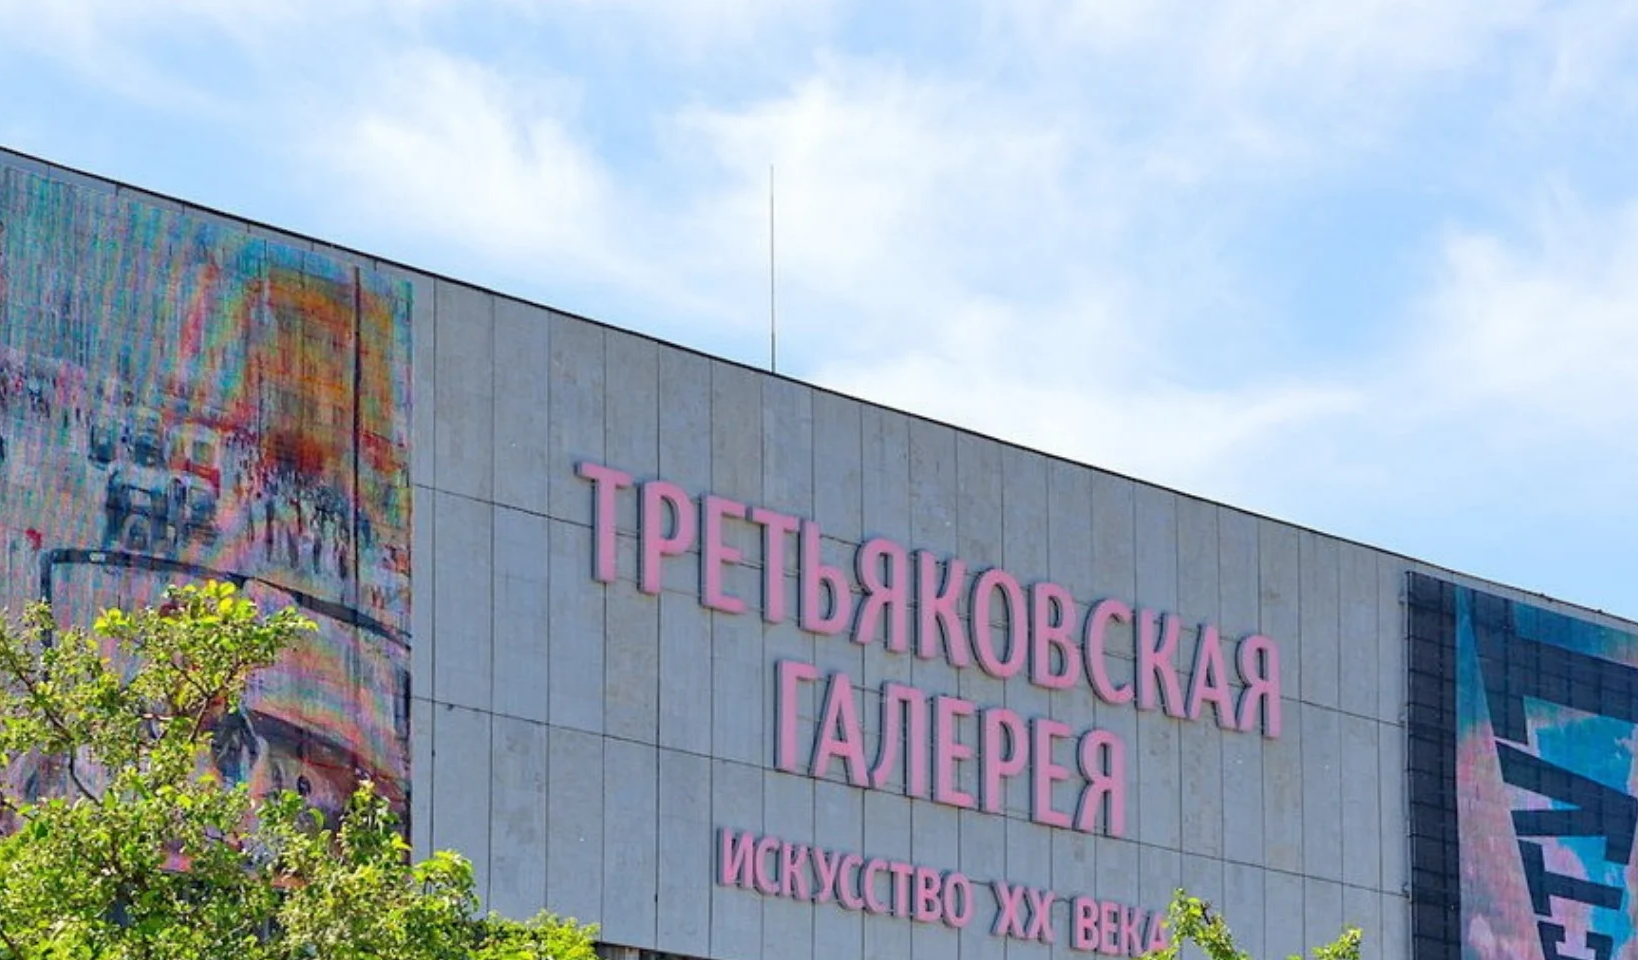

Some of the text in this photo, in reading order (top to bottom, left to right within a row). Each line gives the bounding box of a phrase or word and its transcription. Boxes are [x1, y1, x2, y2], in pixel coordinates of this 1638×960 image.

[575, 460, 1282, 740] ТРЕТЬЯКОВСКАЯ
[775, 659, 1126, 838] ГАЛЕРЕЯ
[717, 828, 973, 930] ИСКУССТВО
[1070, 896, 1169, 958] ВЕКА
